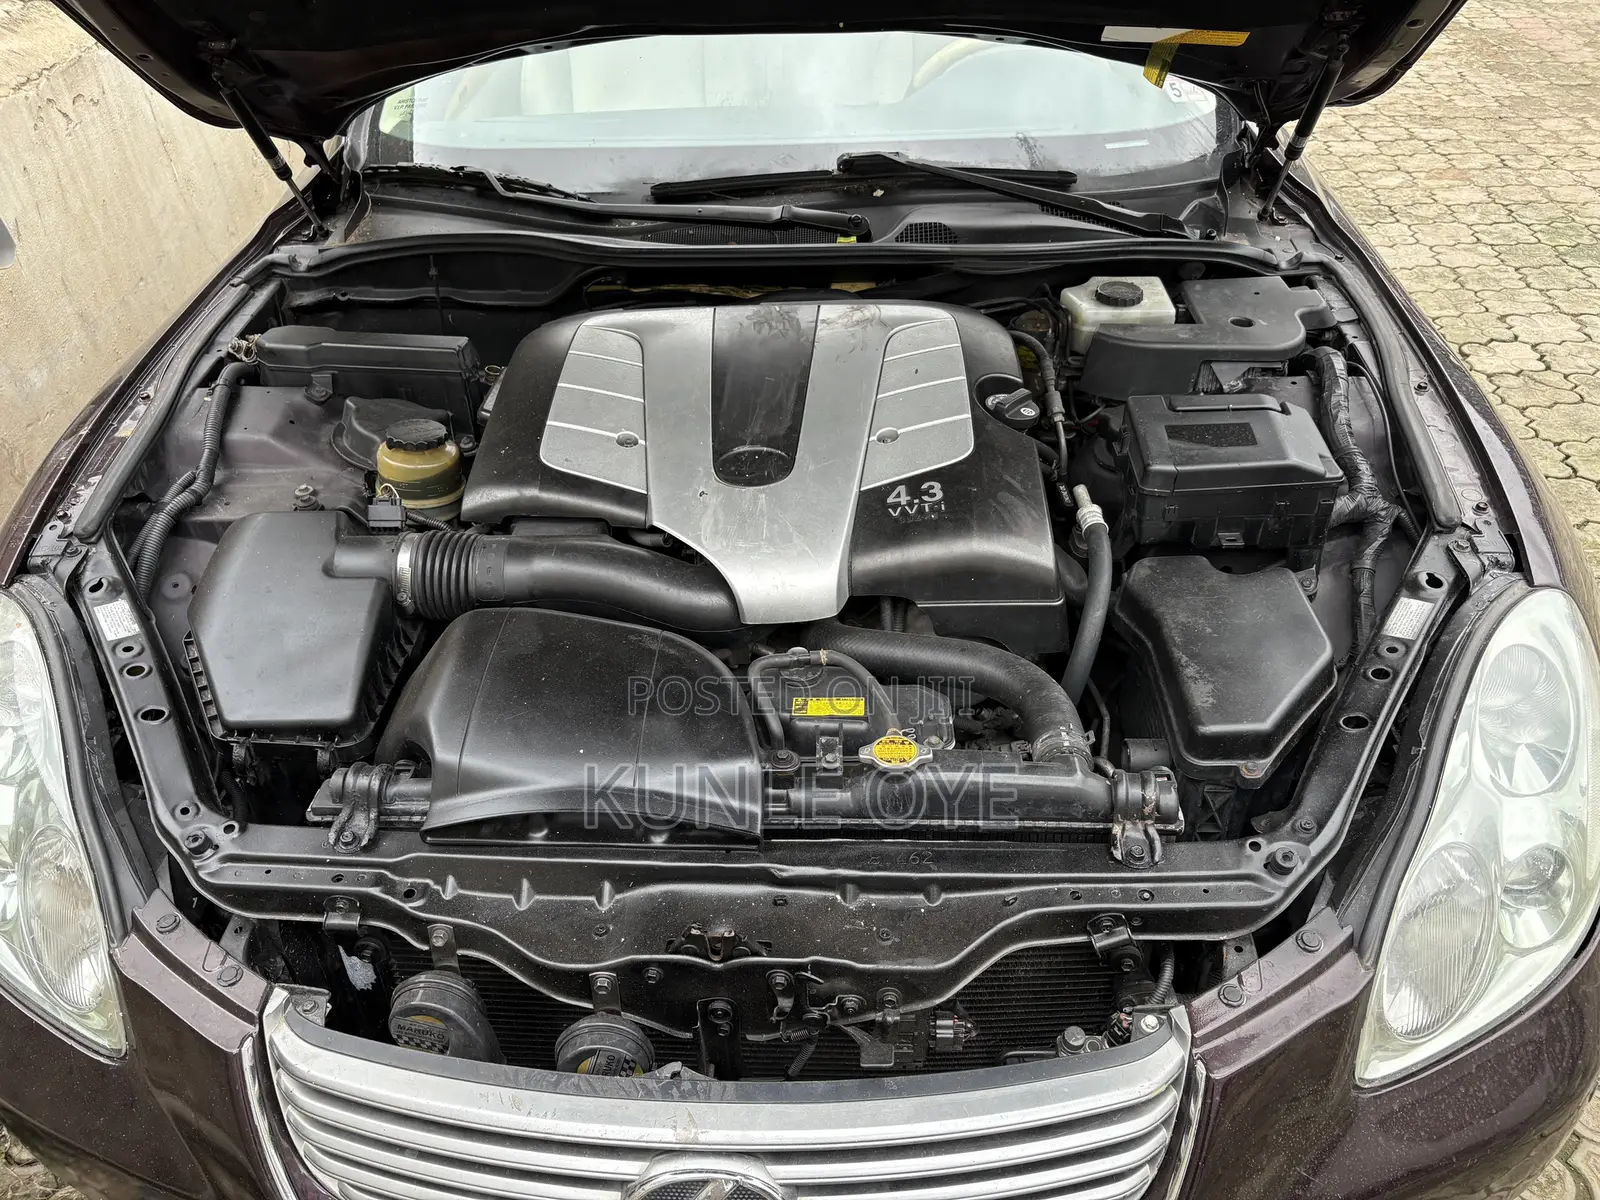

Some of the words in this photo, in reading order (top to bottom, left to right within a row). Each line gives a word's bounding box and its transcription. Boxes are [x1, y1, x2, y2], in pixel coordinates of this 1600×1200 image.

[887, 482, 943, 505] 4.3
[888, 501, 945, 516] VVT-i
[397, 1024, 445, 1040] MARUKO
[601, 1054, 616, 1076] RUKO
